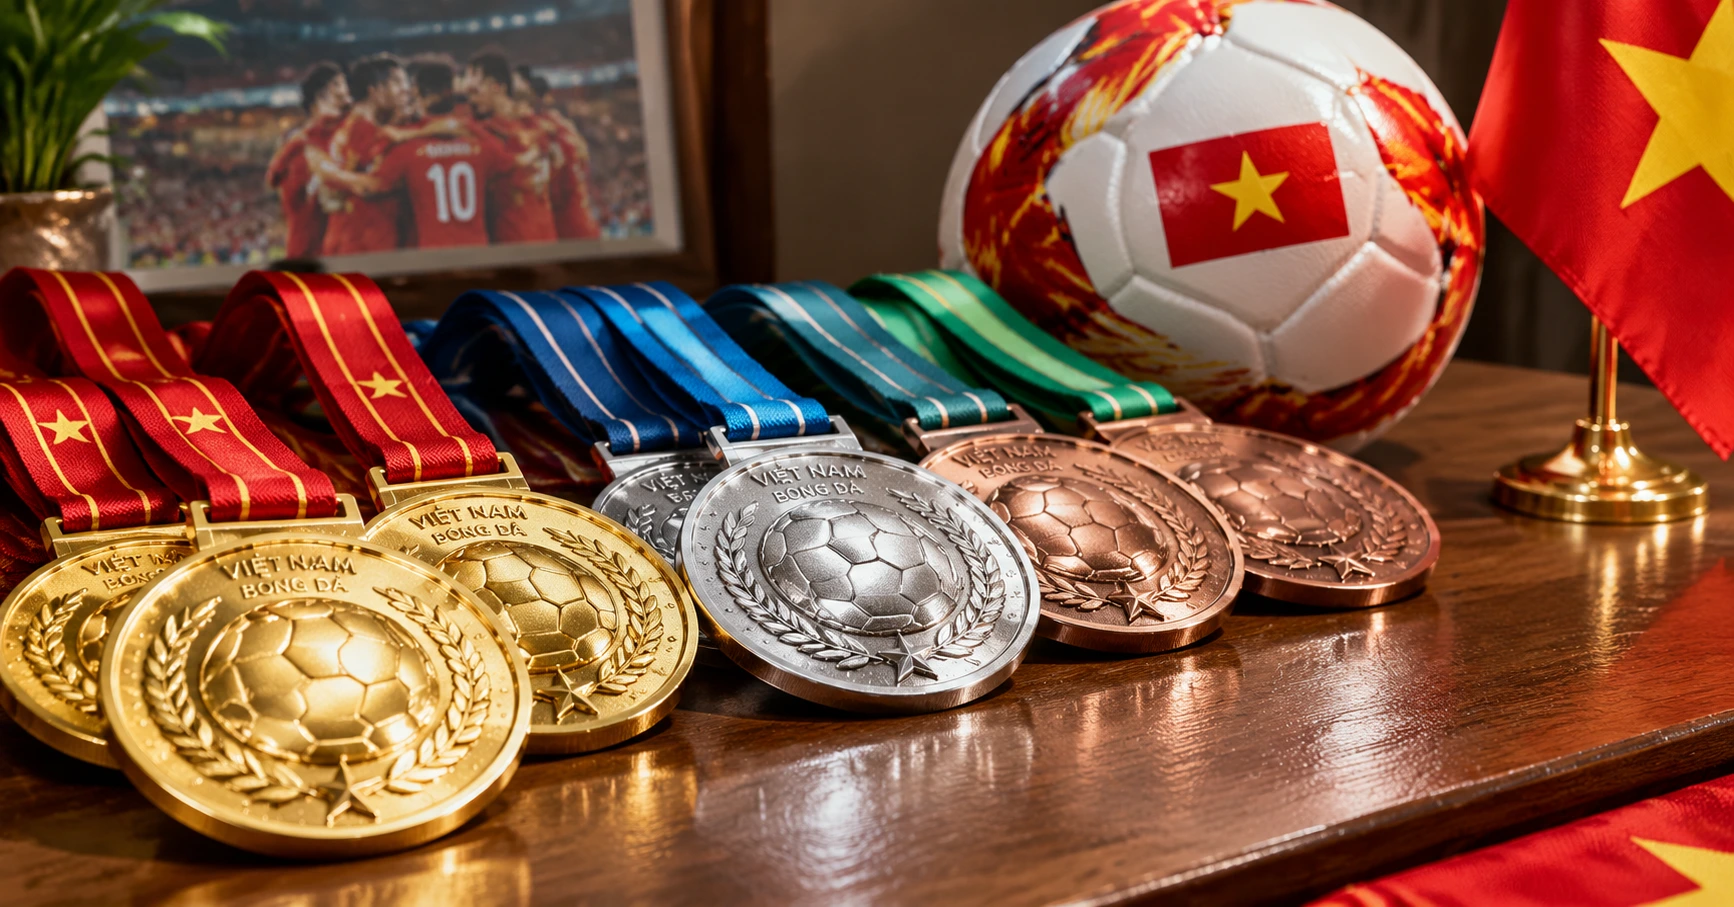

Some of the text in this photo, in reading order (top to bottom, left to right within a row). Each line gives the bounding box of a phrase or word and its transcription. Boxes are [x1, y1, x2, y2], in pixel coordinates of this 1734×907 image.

[427, 161, 476, 223] 10
[1002, 445, 1057, 459] NAM
[806, 463, 867, 479] NAM
[467, 505, 528, 520] NAM
[286, 554, 357, 575] NAM
